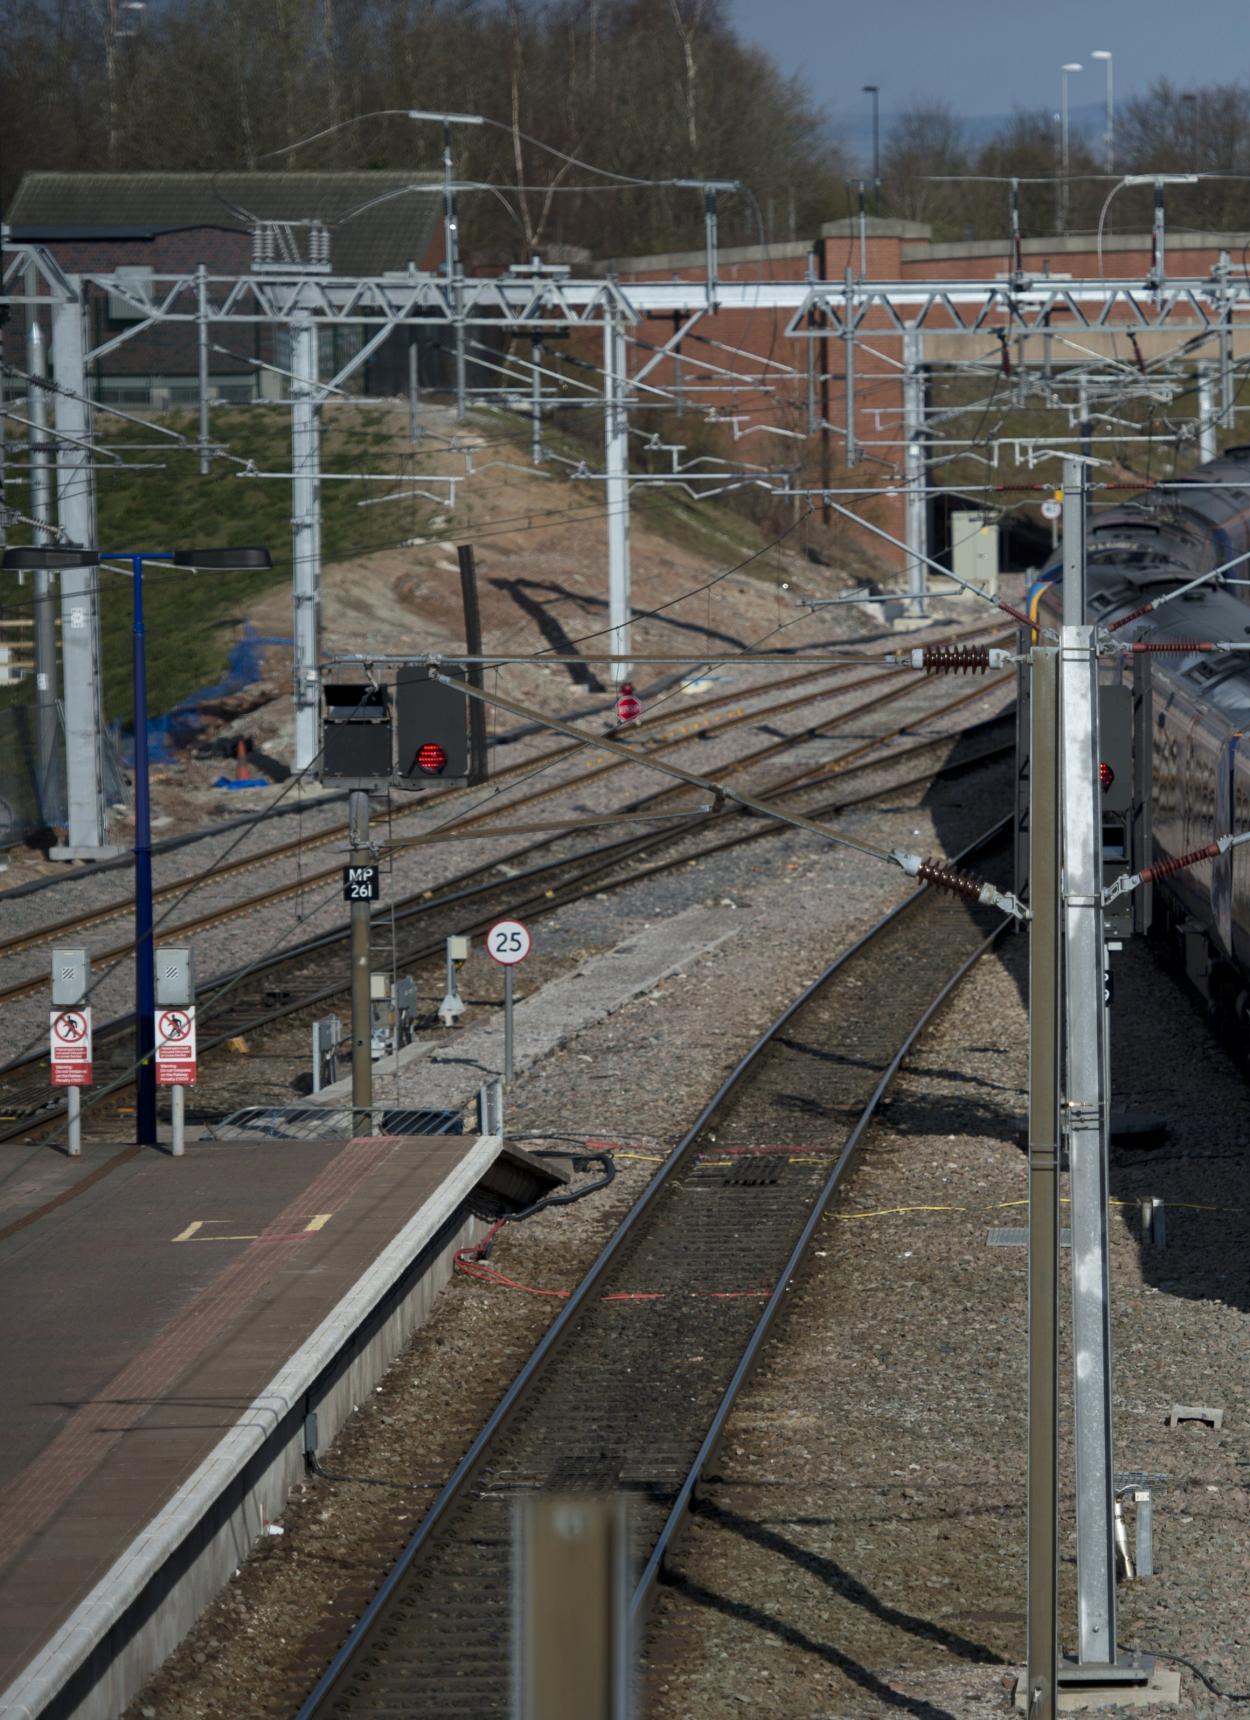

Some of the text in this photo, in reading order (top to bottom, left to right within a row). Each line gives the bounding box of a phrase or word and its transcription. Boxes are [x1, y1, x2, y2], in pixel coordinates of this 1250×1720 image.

[349, 868, 373, 882] MP
[350, 884, 373, 898] 261
[495, 932, 522, 953] 25
